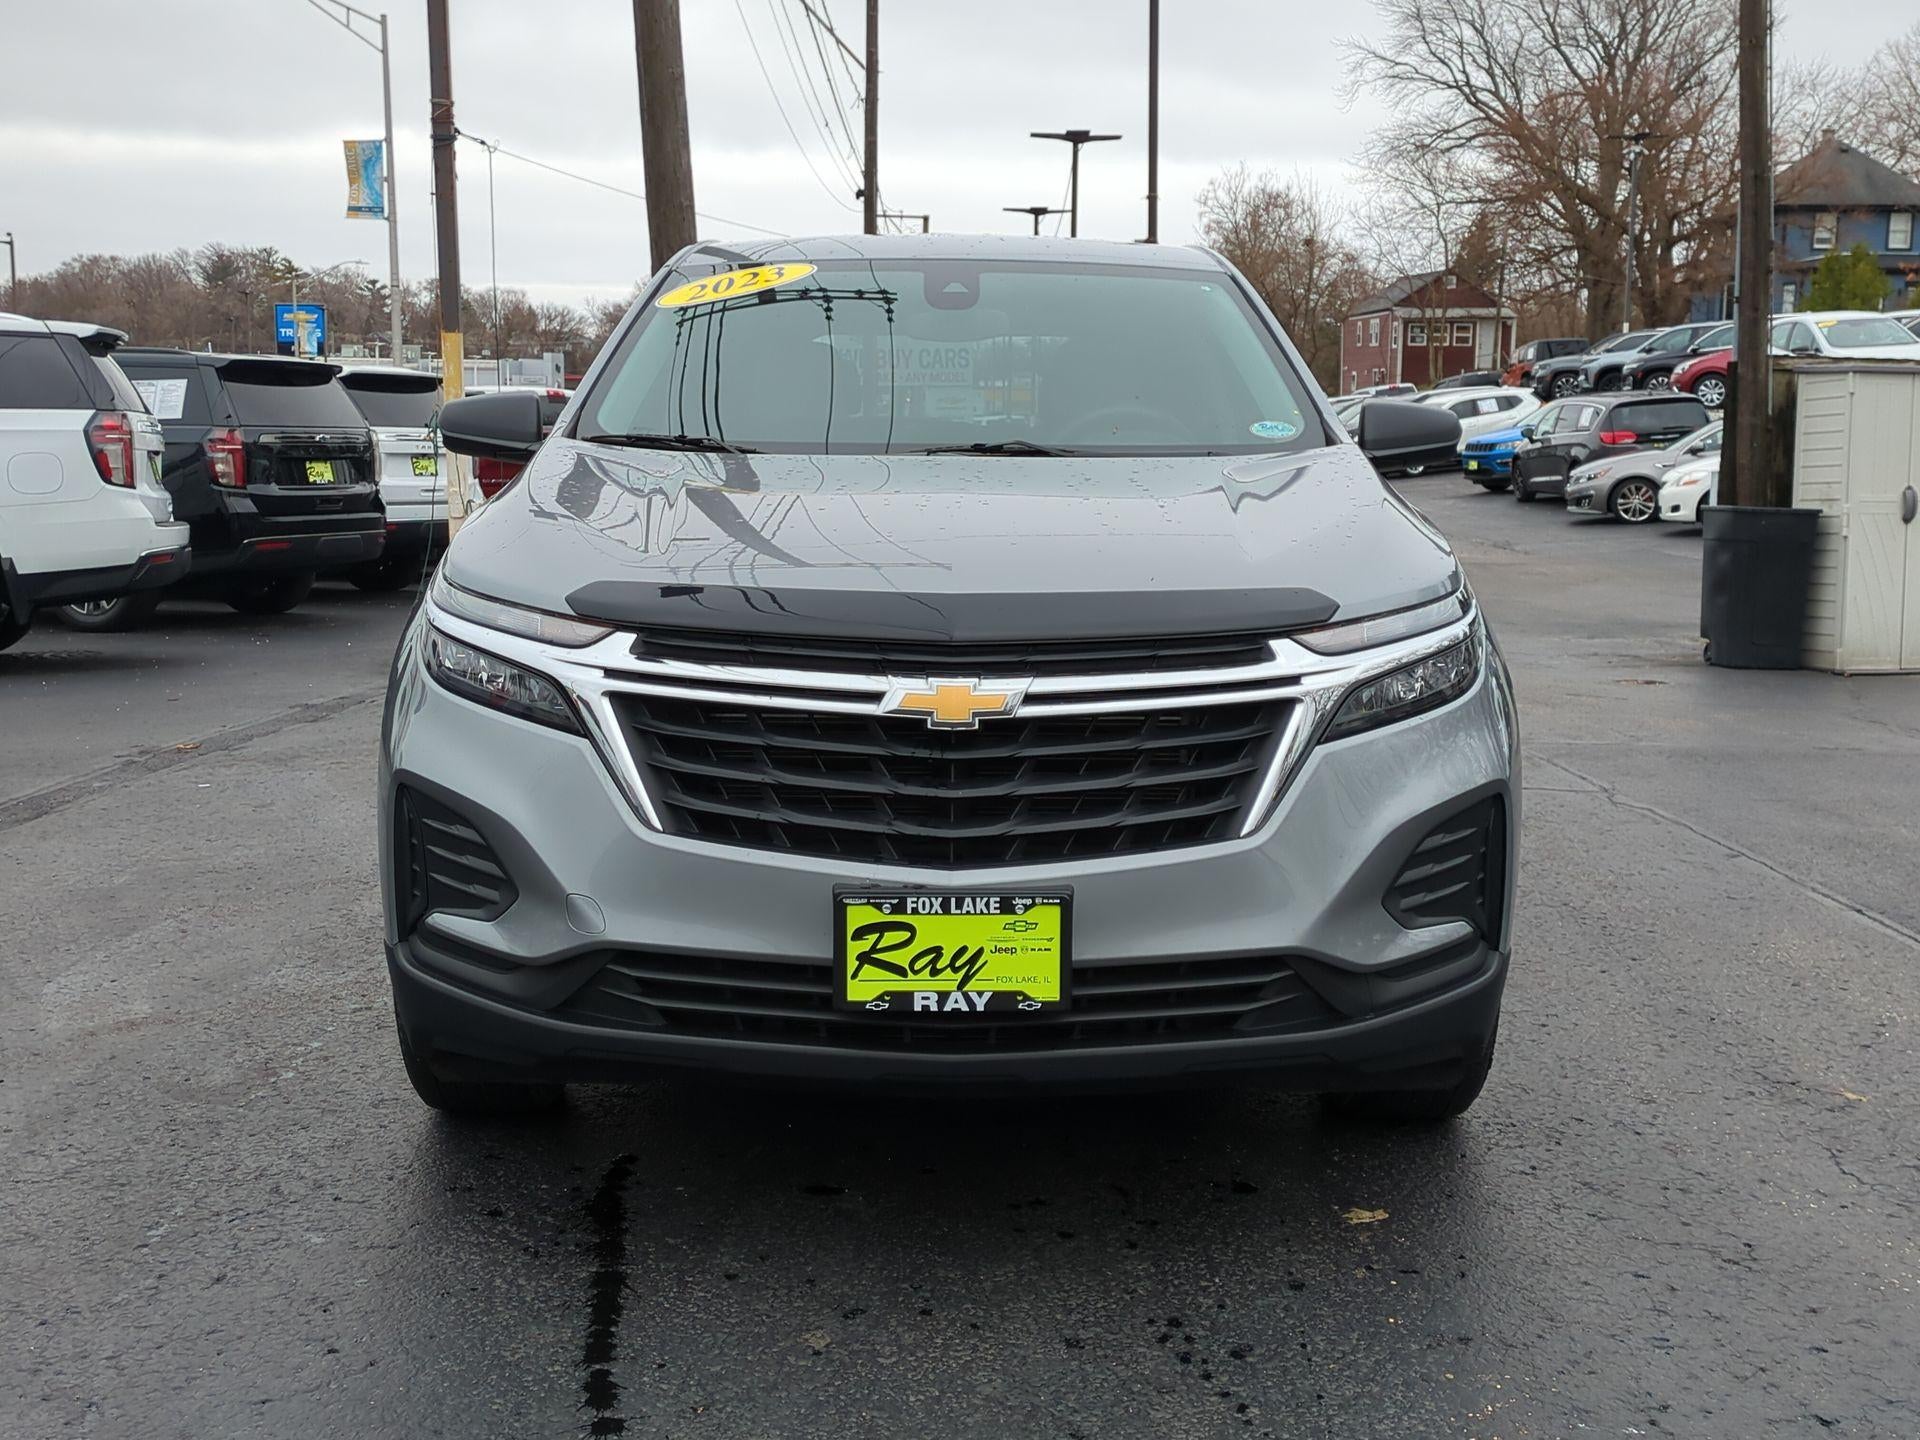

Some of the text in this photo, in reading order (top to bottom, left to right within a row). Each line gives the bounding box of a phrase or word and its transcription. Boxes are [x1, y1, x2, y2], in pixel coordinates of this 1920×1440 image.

[686, 266, 785, 302] 2023
[279, 328, 322, 337] TRS
[918, 347, 970, 369] CARS
[307, 466, 325, 479] Ray
[907, 897, 1001, 914] FOX LAKE
[1012, 897, 1033, 905] Jeep
[850, 920, 989, 992] Ray
[990, 945, 1017, 955] Jeep
[996, 976, 1051, 985] FOX LAKE, IL
[913, 991, 994, 1012] RAY
